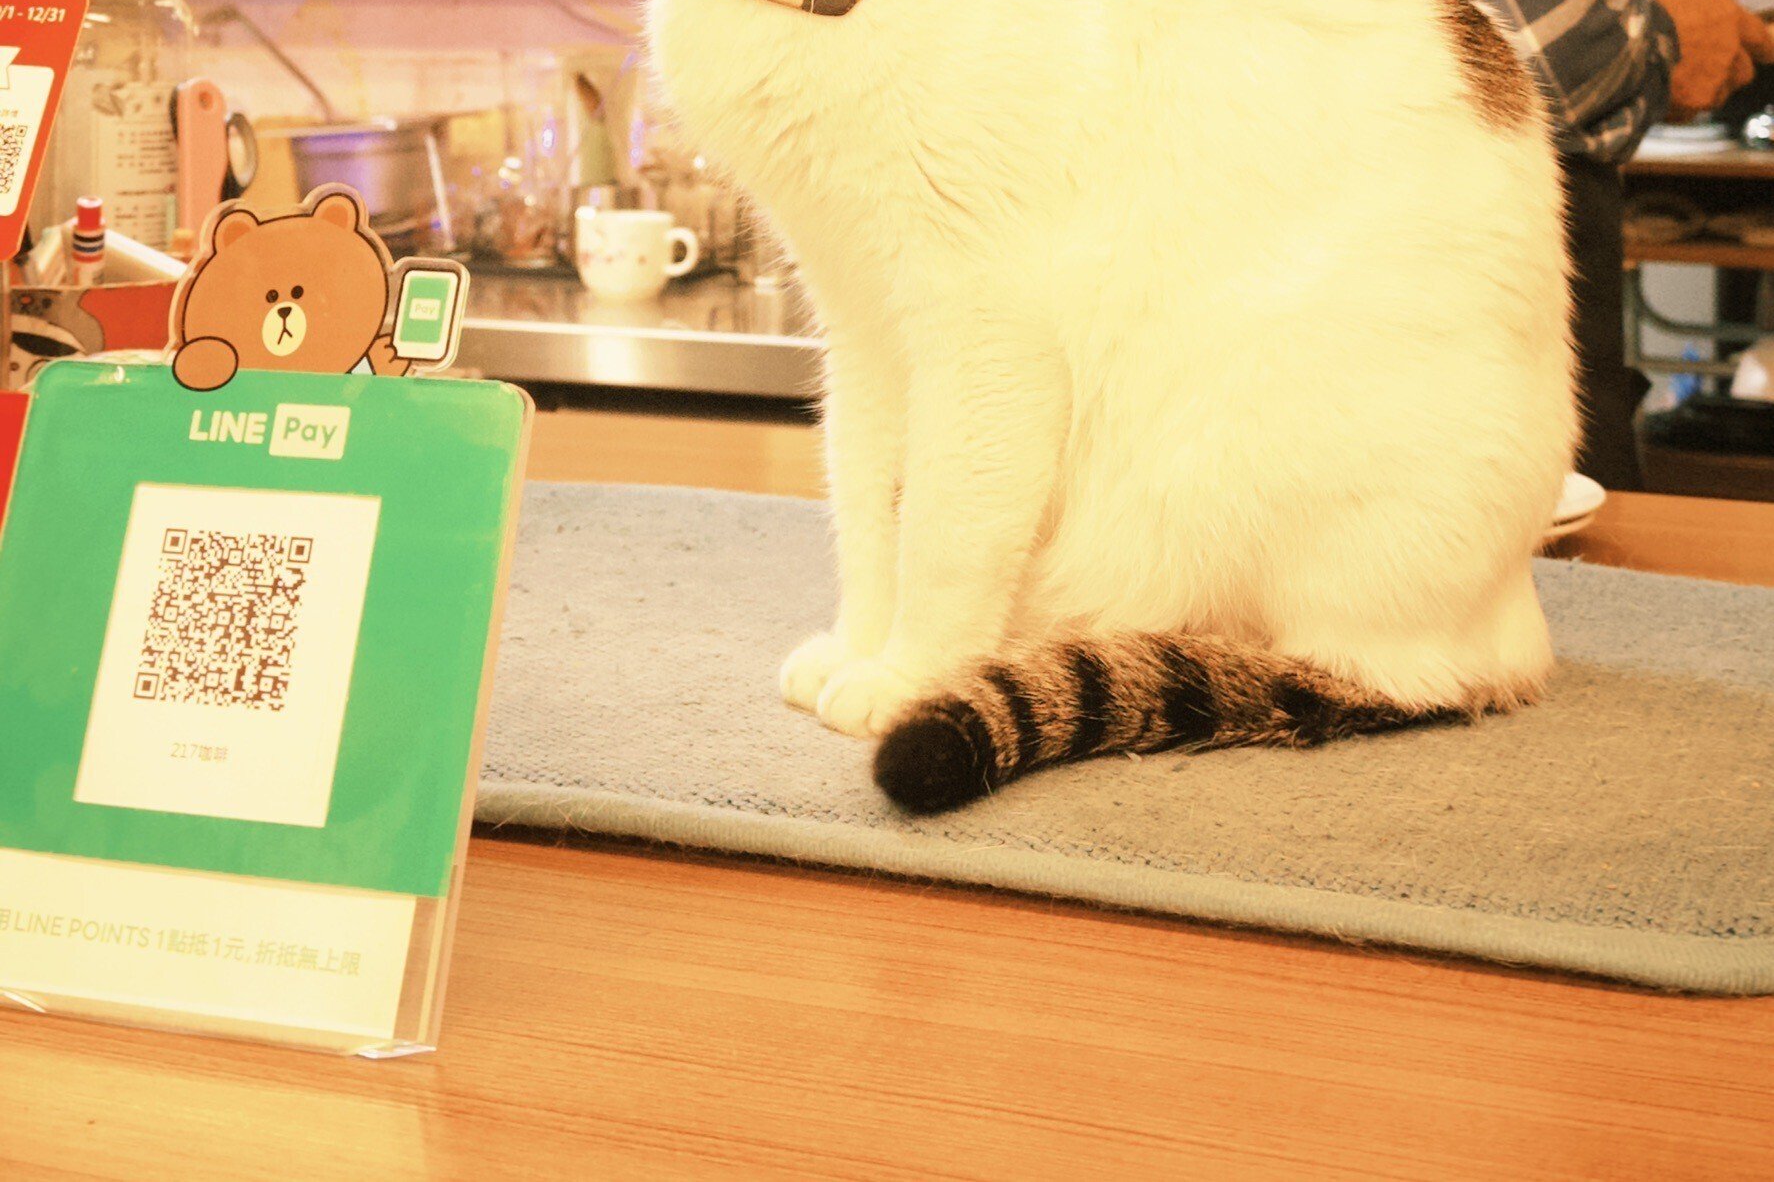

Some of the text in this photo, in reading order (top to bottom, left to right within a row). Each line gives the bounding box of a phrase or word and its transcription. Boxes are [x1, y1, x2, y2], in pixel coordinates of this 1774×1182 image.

[0, 5, 15, 21] /1
[28, 6, 66, 24] 12/31
[415, 304, 435, 315] Pay
[188, 409, 338, 450] LINE Pay
[14, 910, 65, 937] LINE
[68, 918, 151, 949] POINTS
